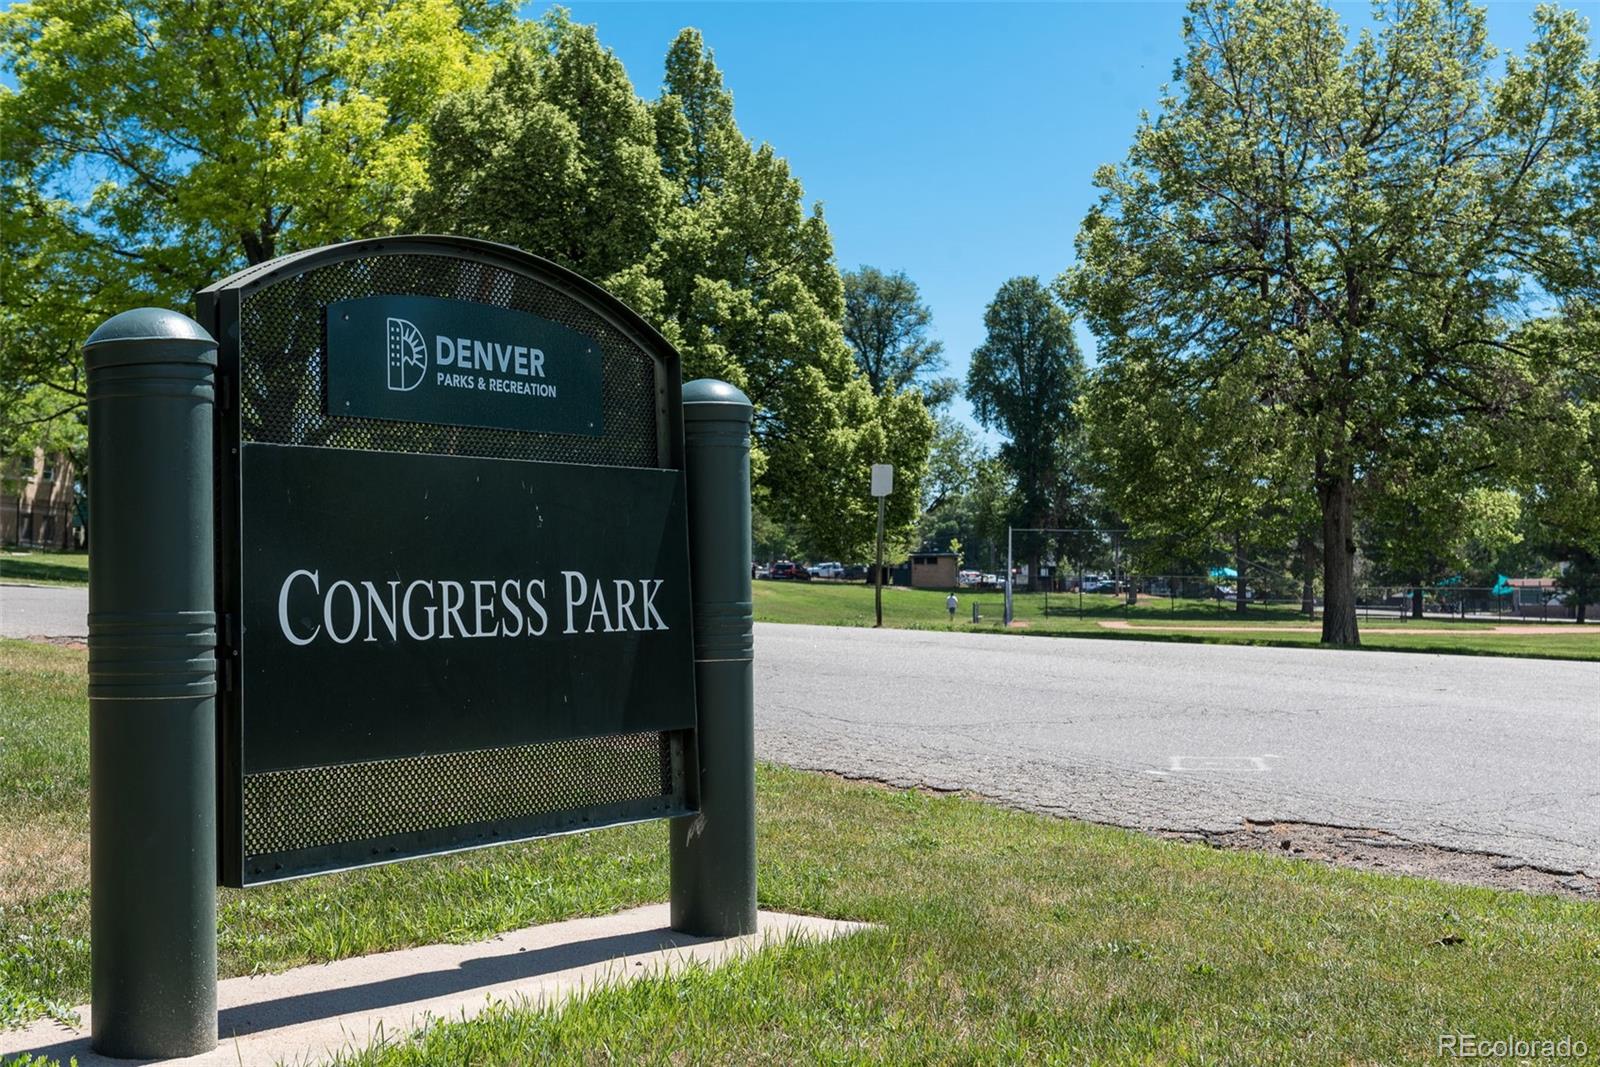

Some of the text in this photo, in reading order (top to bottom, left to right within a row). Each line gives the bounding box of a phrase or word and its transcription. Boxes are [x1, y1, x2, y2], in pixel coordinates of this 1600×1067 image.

[436, 335, 545, 377] DENVER
[436, 372, 557, 398] PARKS & RECREATION
[278, 568, 670, 646] CONGRESS PARK
